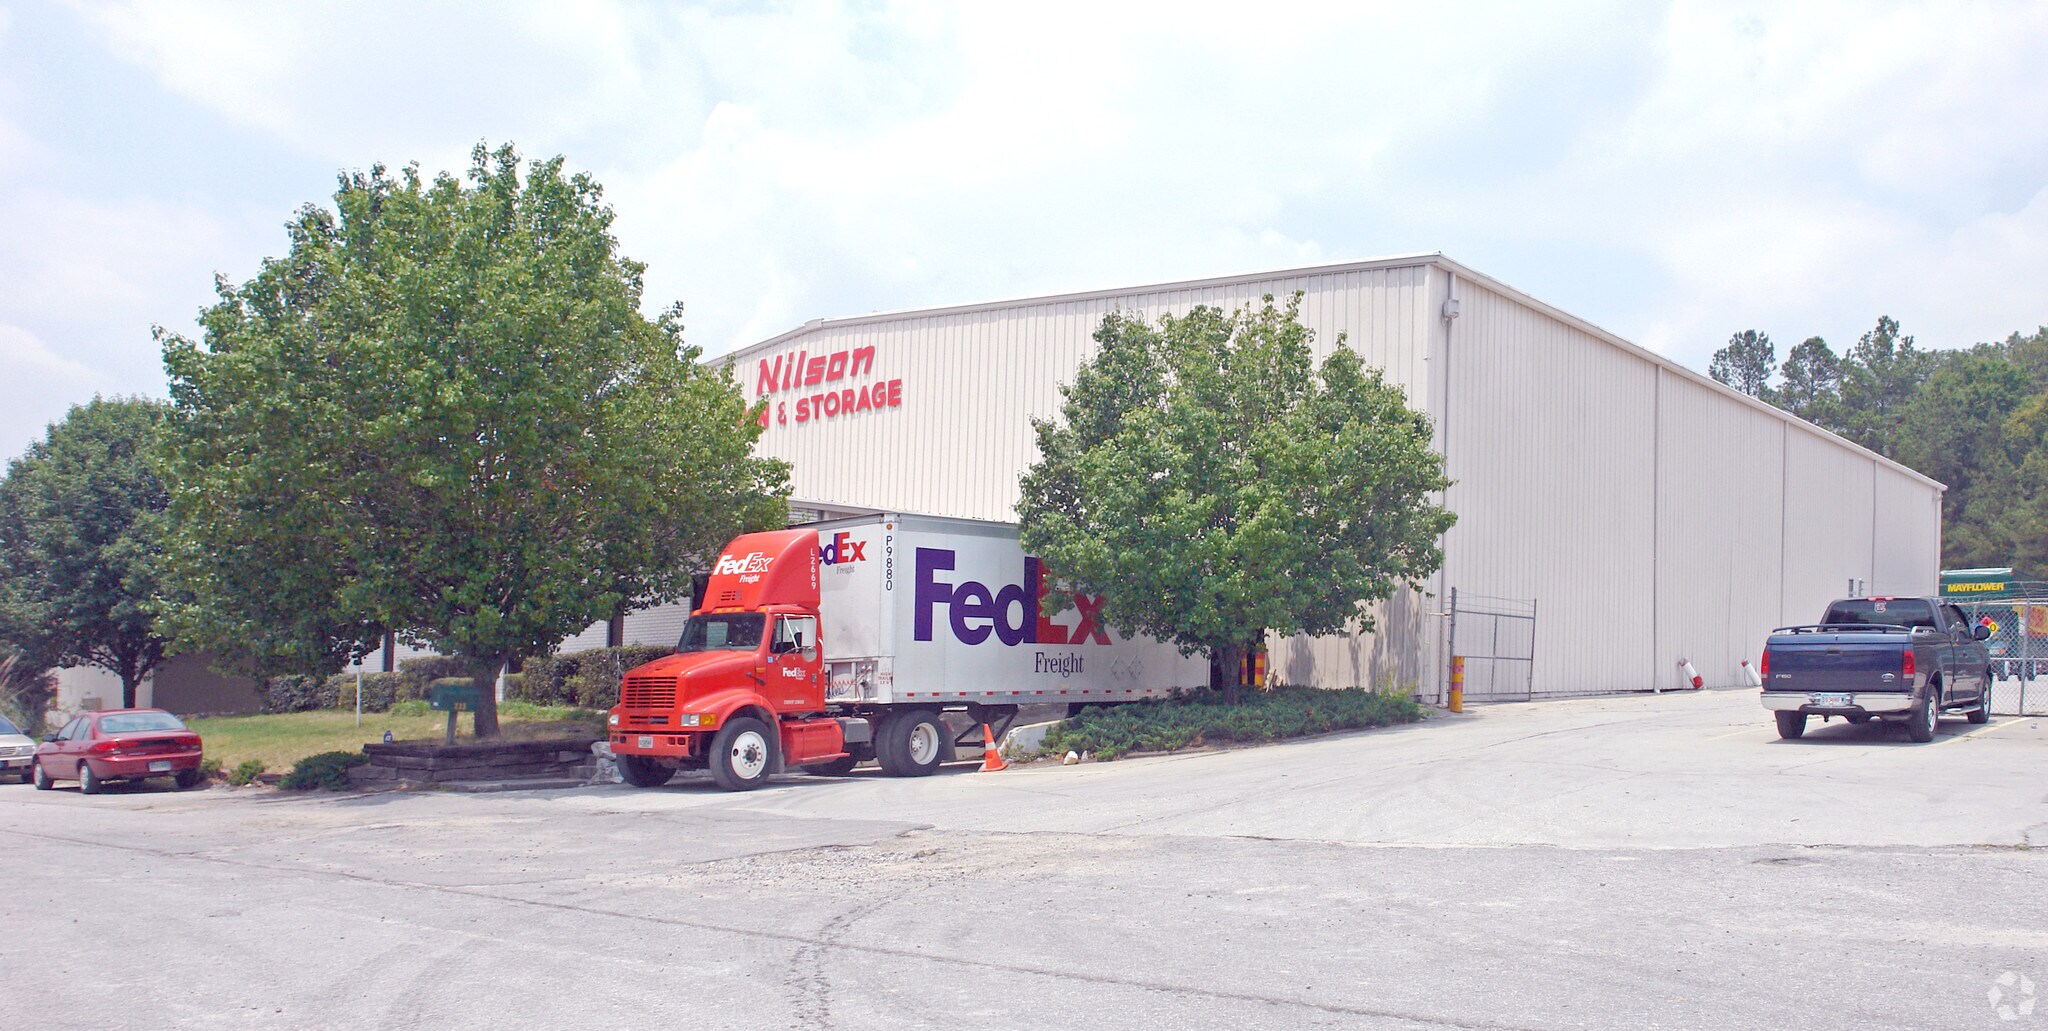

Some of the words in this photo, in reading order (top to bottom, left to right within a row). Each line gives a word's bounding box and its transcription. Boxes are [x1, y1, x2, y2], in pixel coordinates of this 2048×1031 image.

[756, 345, 875, 396] Nilson
[777, 401, 787, 425] &
[795, 378, 902, 423] STORAGE
[713, 551, 775, 576] FedEx
[819, 532, 867, 566] dEx
[885, 535, 893, 591] P9880
[914, 547, 1113, 647] FedEx
[1947, 582, 2005, 593] MAYFLOWER
[1034, 652, 1085, 678] Freight
